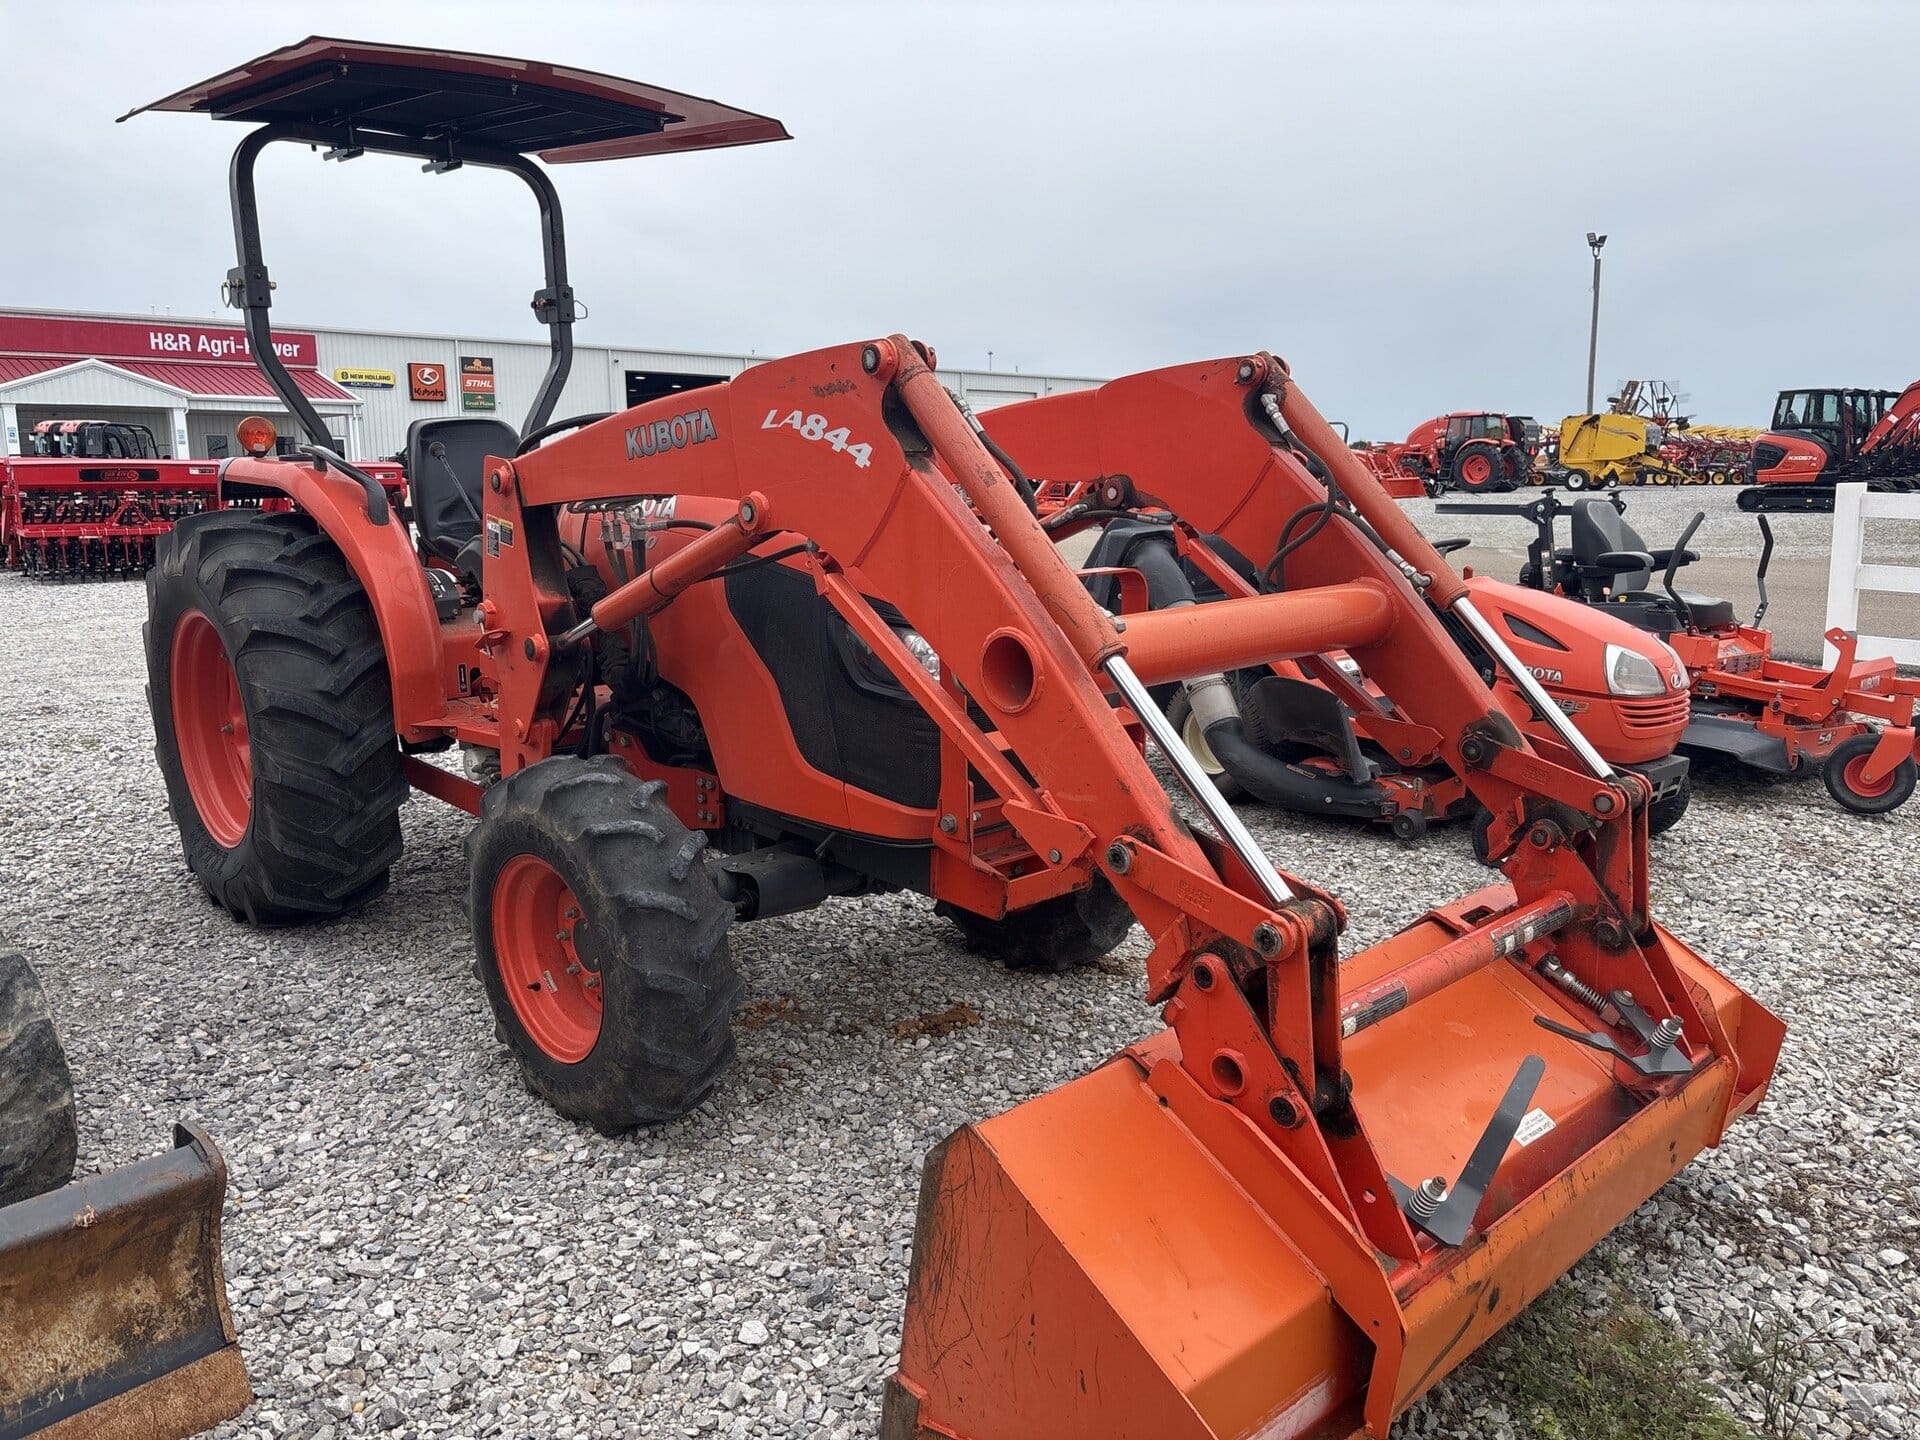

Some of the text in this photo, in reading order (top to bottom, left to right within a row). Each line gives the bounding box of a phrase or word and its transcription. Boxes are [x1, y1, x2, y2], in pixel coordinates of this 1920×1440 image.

[150, 332, 192, 352] H&R
[414, 387, 444, 397] Kubota
[464, 379, 493, 388] STIHL
[624, 408, 718, 460] KUBOTA
[761, 409, 873, 469] LA844
